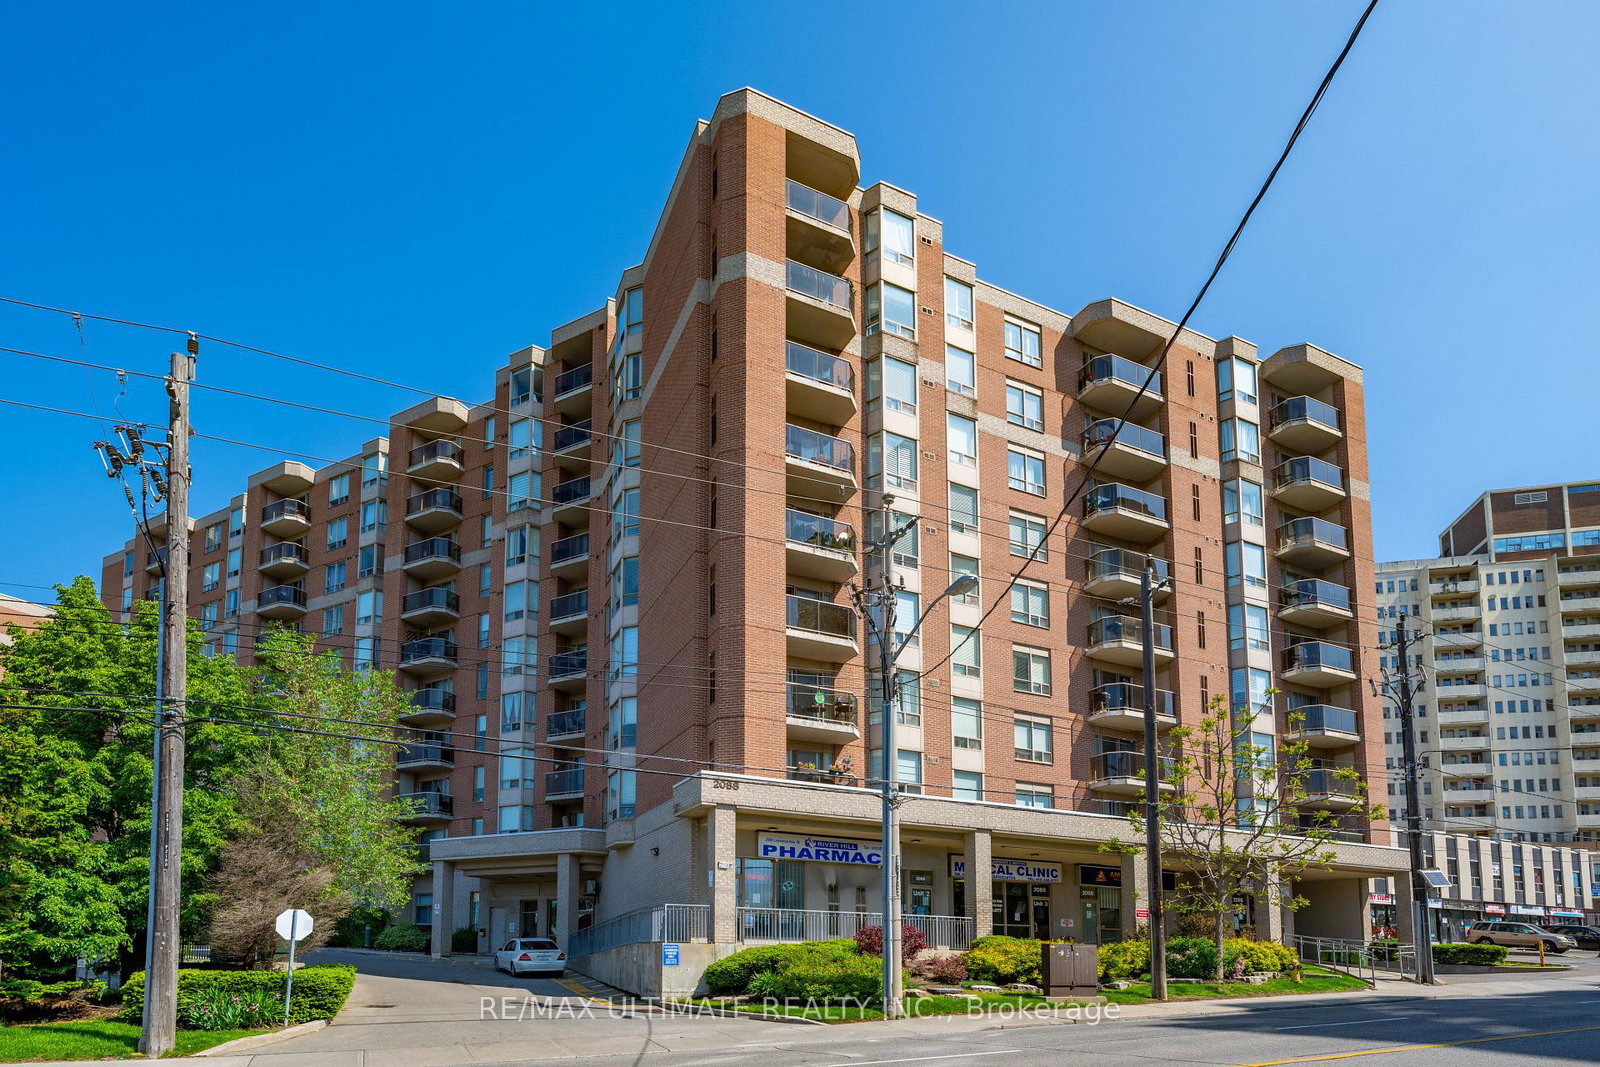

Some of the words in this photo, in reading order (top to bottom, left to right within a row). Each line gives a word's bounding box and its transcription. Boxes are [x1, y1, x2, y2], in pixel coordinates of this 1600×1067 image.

[713, 780, 739, 791] 2088
[817, 840, 840, 849] RIVER
[840, 842, 857, 850] HILL
[762, 844, 882, 865] PHARMAC
[954, 861, 1013, 876] MCAL
[1016, 866, 1059, 879] CLINIC
